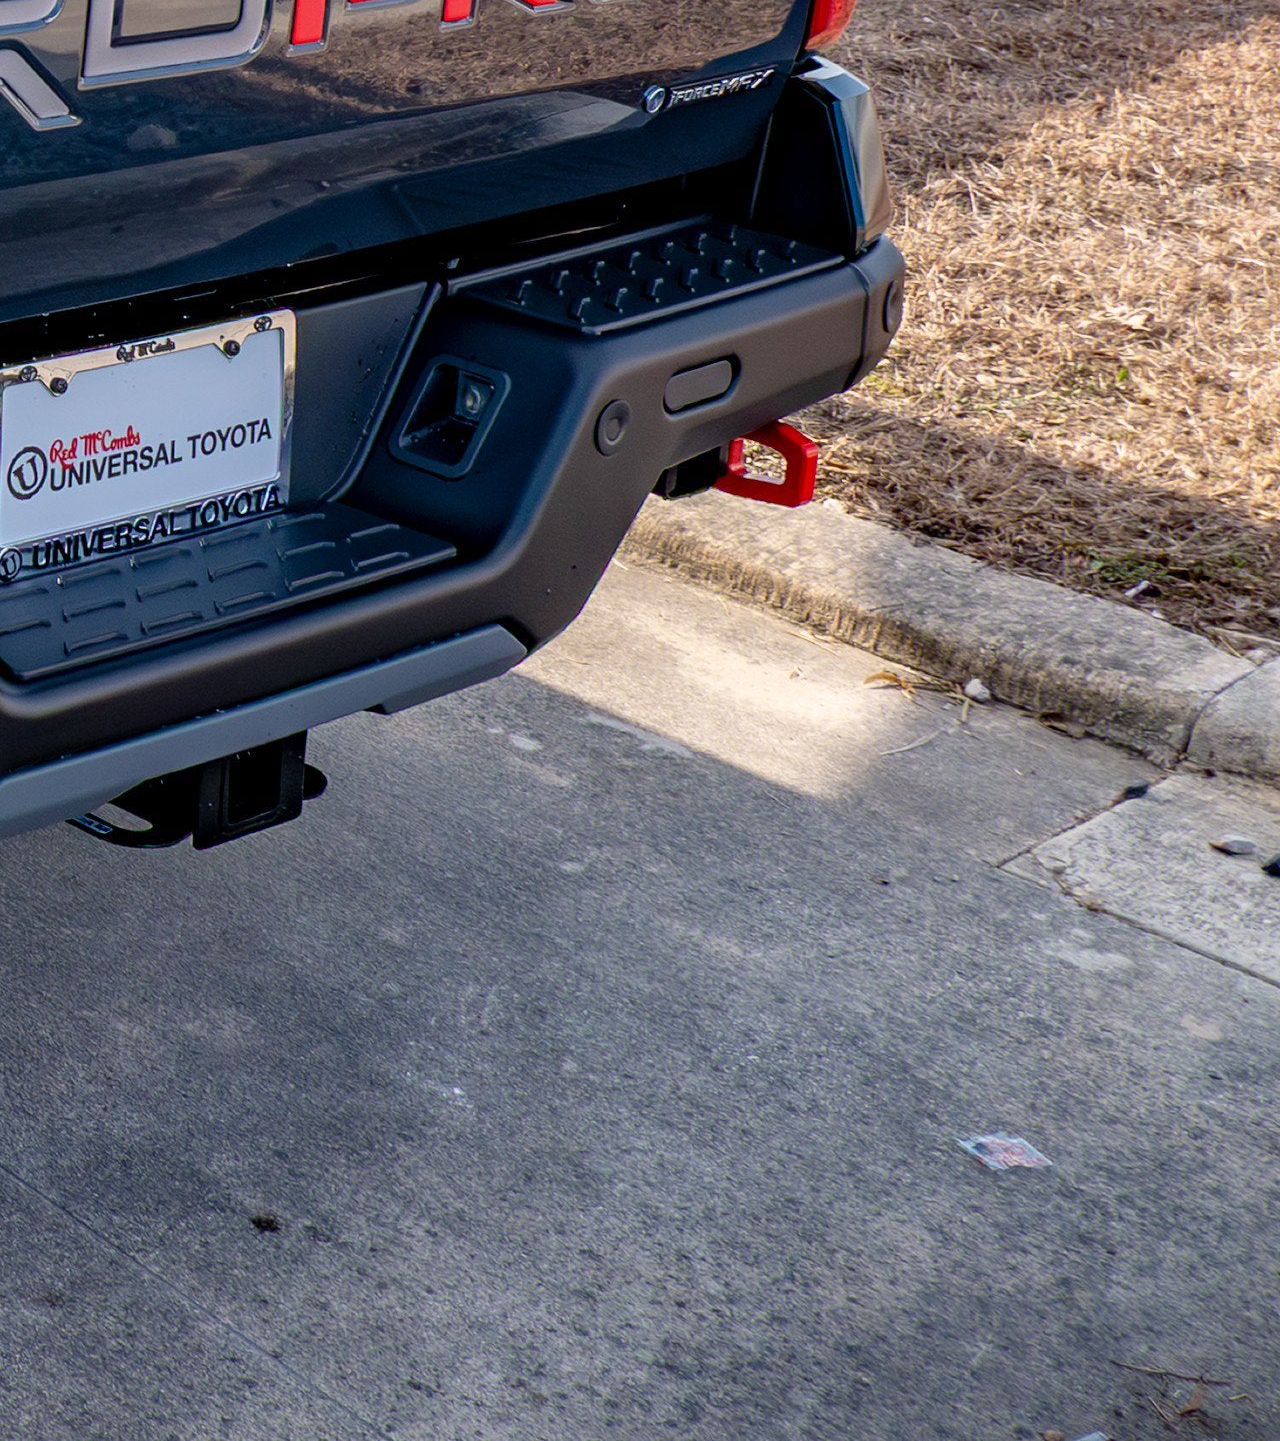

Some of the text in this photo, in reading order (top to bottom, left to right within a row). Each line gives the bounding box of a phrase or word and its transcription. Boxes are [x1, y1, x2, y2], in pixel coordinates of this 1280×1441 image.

[49, 437, 79, 469] Red
[49, 417, 272, 492] UNIVERSAL TOYOTA
[31, 483, 281, 569] UNIVERSAL TOYOTA
